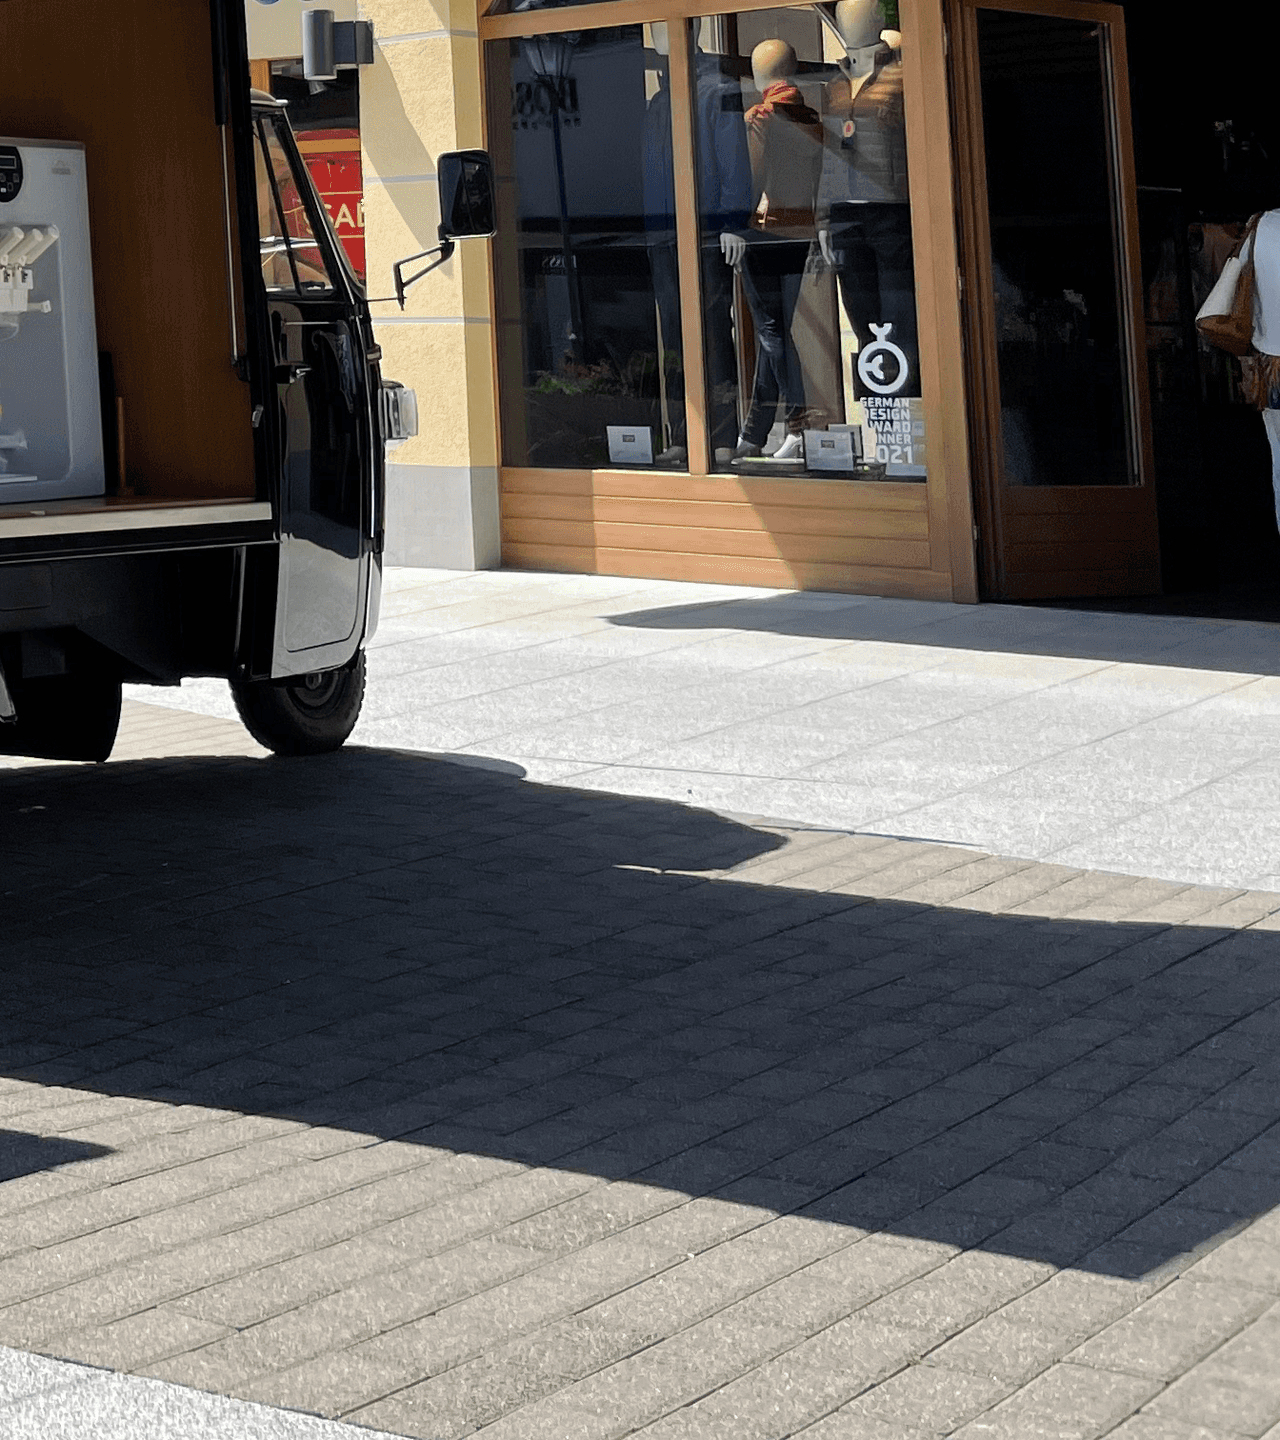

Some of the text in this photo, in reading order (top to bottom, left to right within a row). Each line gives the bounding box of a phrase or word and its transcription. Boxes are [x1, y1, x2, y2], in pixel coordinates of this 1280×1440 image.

[860, 396, 910, 408] GERMAN
[868, 420, 911, 433] WARD
[876, 433, 912, 445] NNER
[875, 445, 913, 464] 021
